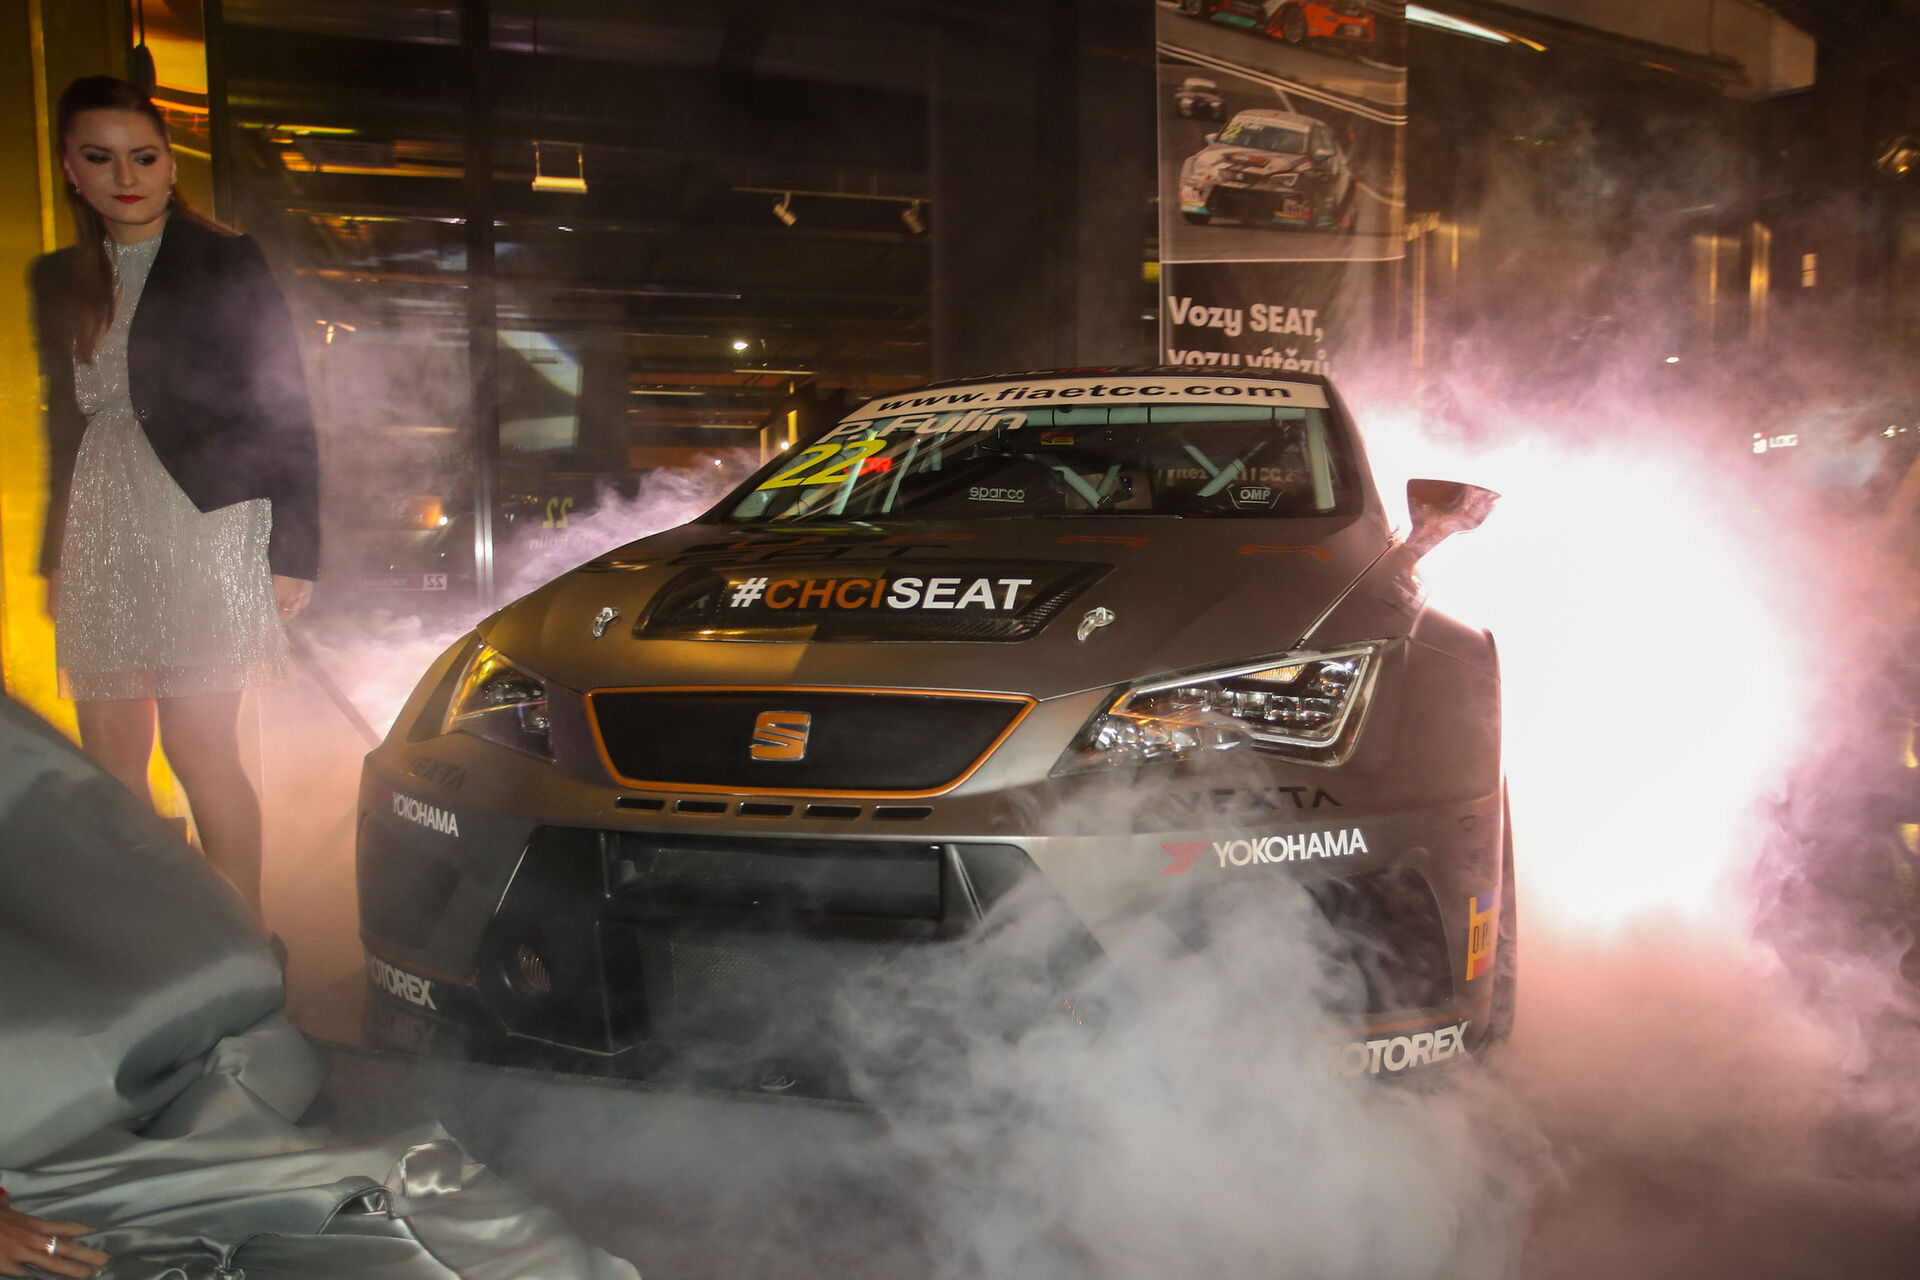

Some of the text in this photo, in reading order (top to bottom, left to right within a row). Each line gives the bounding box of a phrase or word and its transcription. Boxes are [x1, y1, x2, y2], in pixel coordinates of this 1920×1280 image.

[1167, 295, 1324, 342] Vozy SEAT,
[878, 383, 1292, 412] www.fiaetcc.com
[815, 407, 1028, 444] P. Fulín
[756, 439, 888, 491] 22
[968, 486, 1025, 502] sparco
[1239, 488, 1272, 501] OMP
[730, 577, 1033, 610] #CHCISEAT
[393, 791, 460, 838] YOKOHAMA
[1212, 828, 1369, 868] YOKOHAMA
